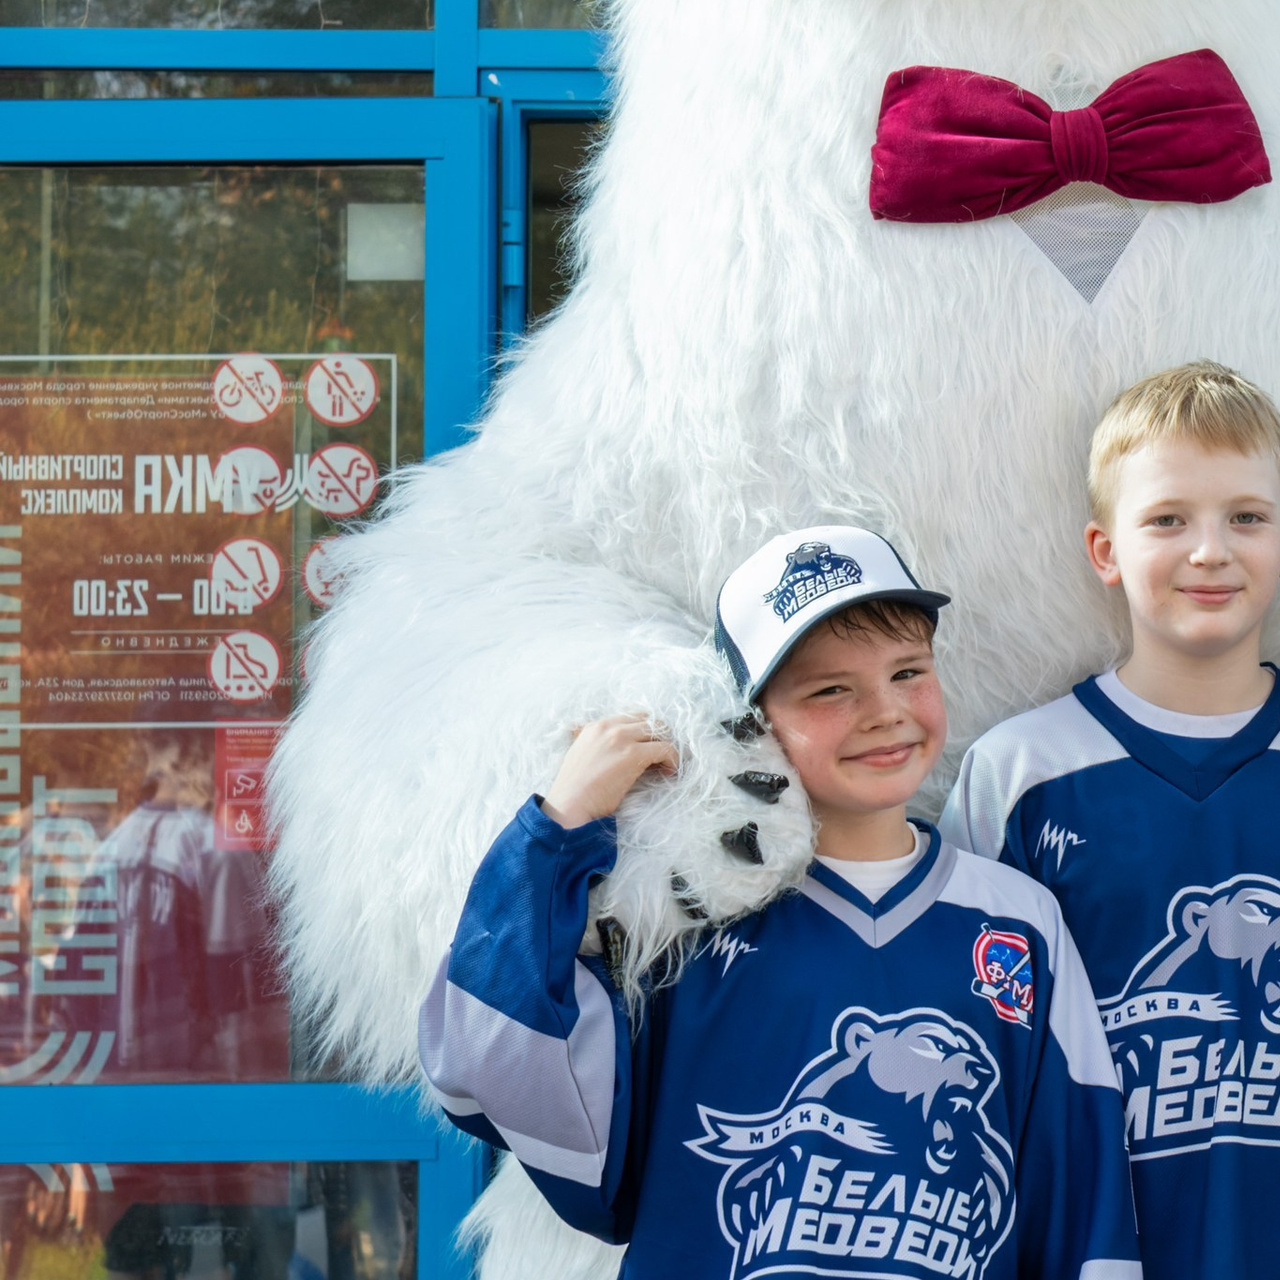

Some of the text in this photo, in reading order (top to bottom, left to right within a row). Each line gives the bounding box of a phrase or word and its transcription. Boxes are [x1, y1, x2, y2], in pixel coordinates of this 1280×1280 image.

[783, 575, 859, 621] МЕДВЕДИ
[794, 566, 848, 598] БЕЛЫЕ
[749, 1110, 846, 1145] МОСКВА
[798, 1154, 972, 1233] БЕЛЫЕ
